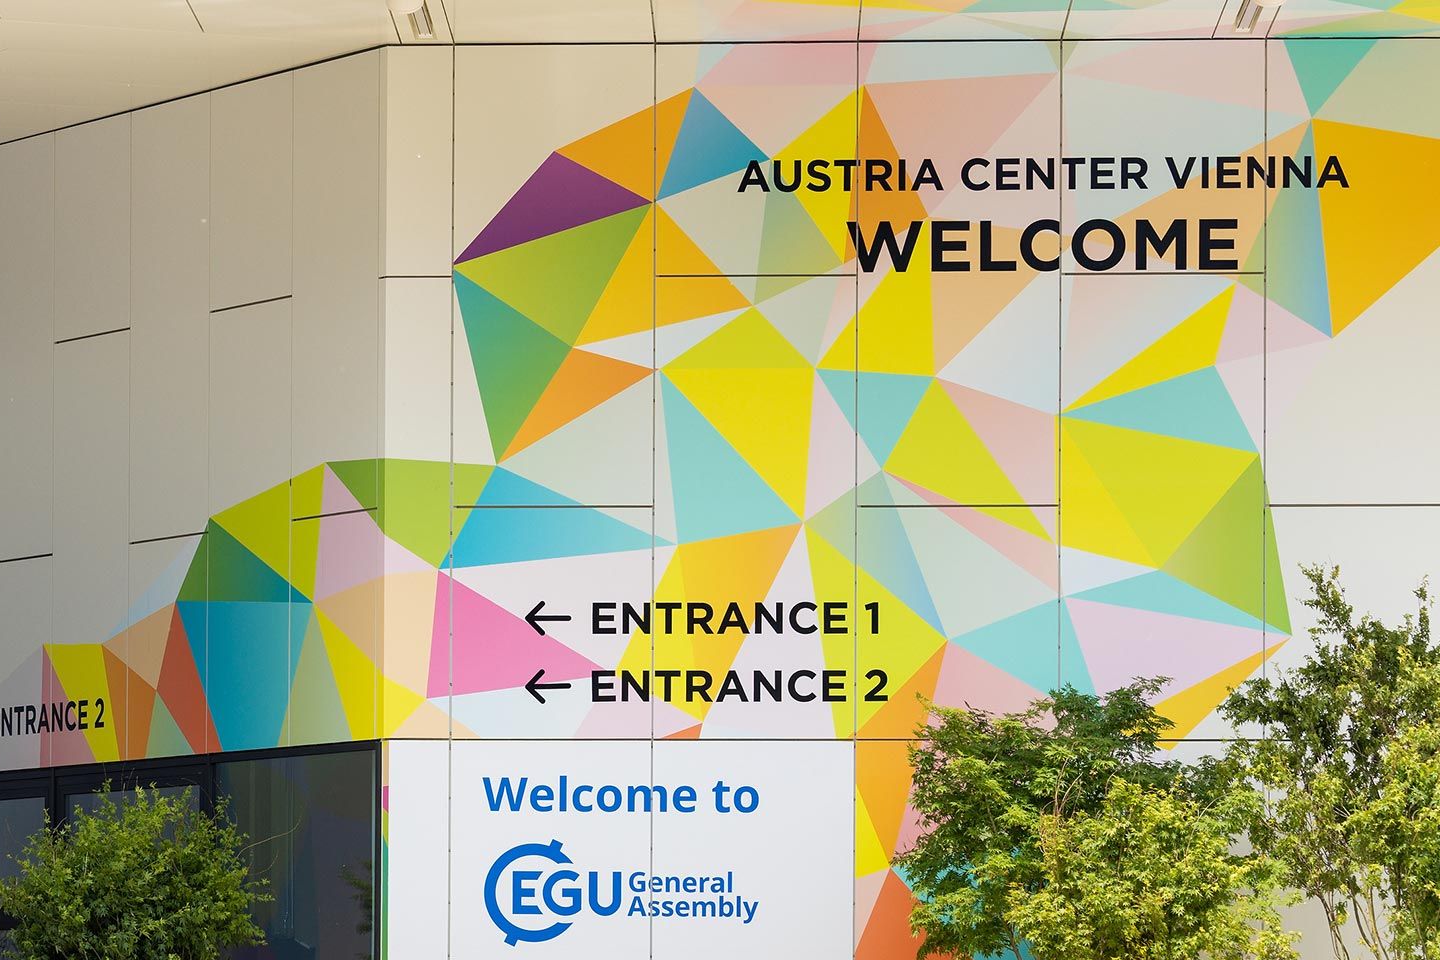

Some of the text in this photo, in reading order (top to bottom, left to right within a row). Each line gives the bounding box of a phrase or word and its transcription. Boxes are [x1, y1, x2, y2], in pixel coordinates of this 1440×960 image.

[738, 156, 1349, 192] AUSTRIA CENTER VIENNA
[847, 219, 1240, 272] WELCOME
[593, 602, 880, 634] ENTRANCE 1
[592, 669, 888, 702] ENTRANCE 2
[95, 698, 105, 728] 2
[483, 775, 760, 814] Welcome to
[512, 870, 622, 917] EGU
[629, 870, 734, 894] General
[627, 896, 759, 924] Assembly
